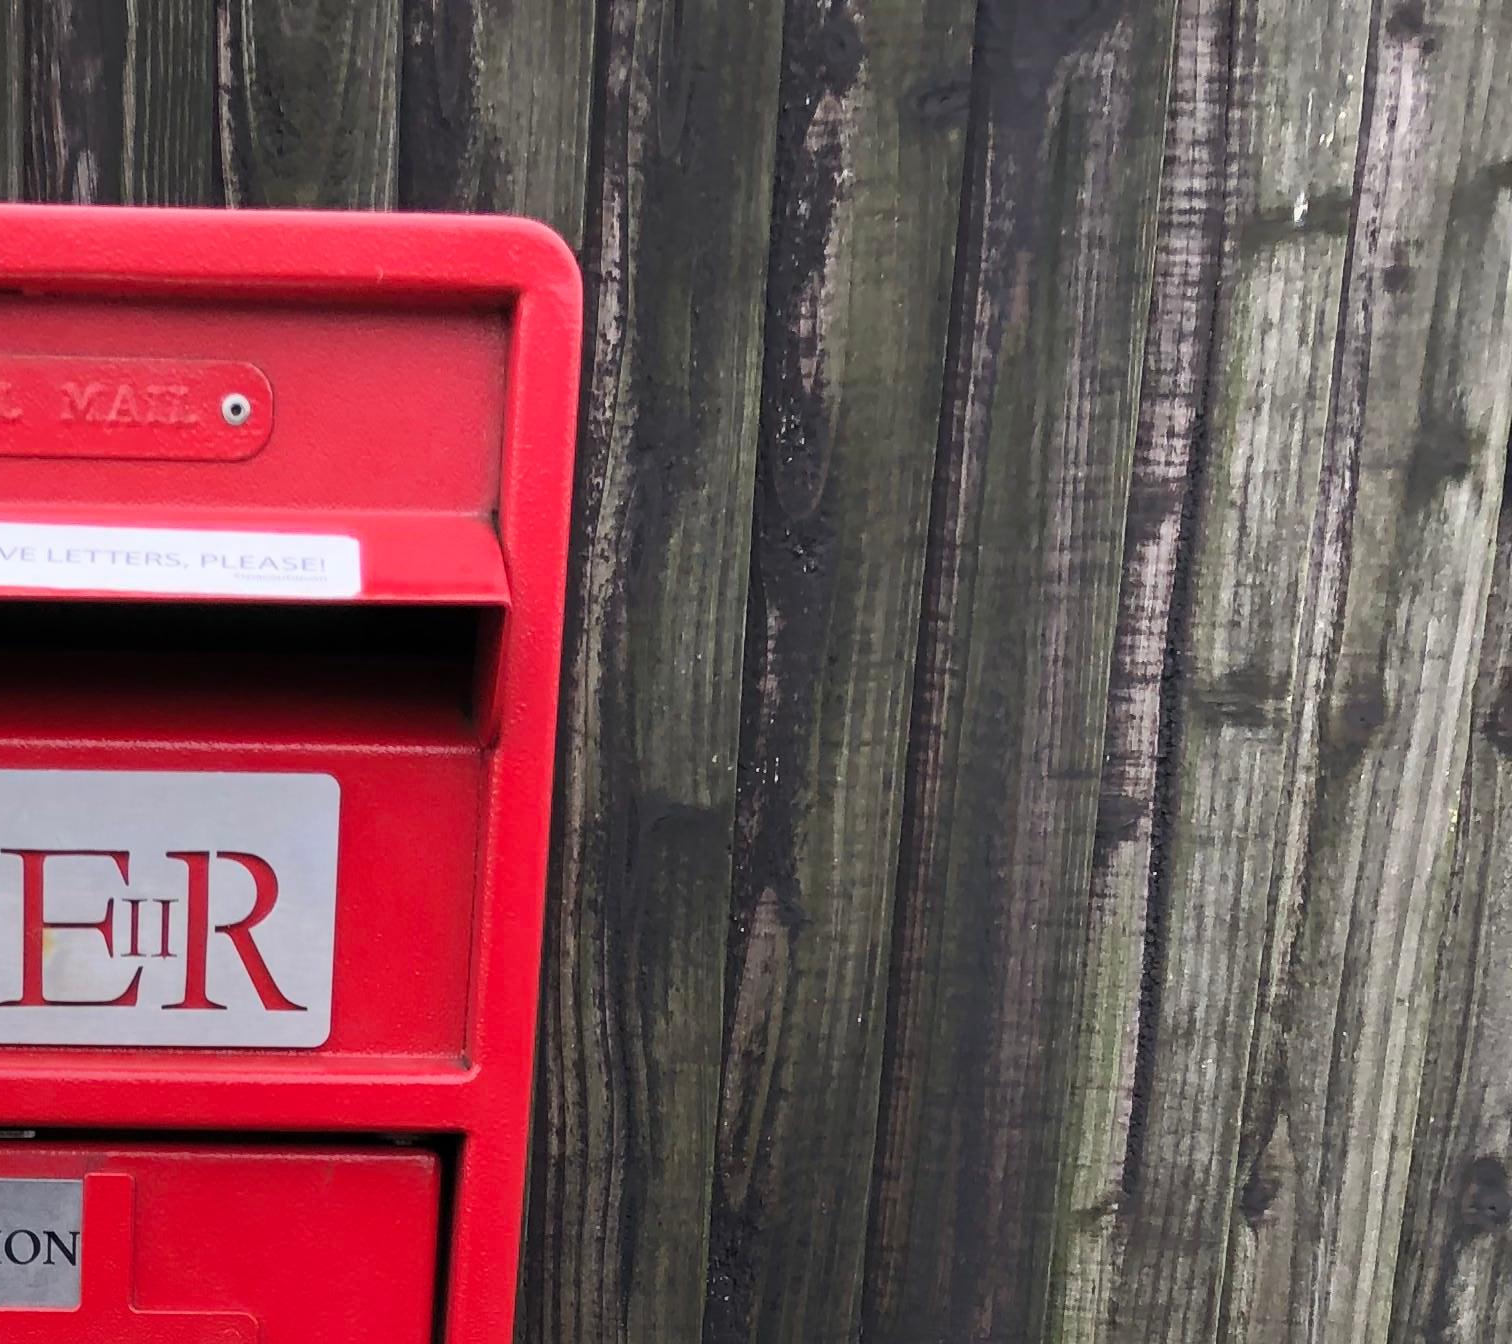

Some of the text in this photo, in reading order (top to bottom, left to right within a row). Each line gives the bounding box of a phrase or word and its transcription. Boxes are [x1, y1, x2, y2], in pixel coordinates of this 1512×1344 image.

[58, 381, 201, 429] MAIL
[47, 548, 188, 571] LETTERS,
[200, 554, 327, 572] PLEASE!
